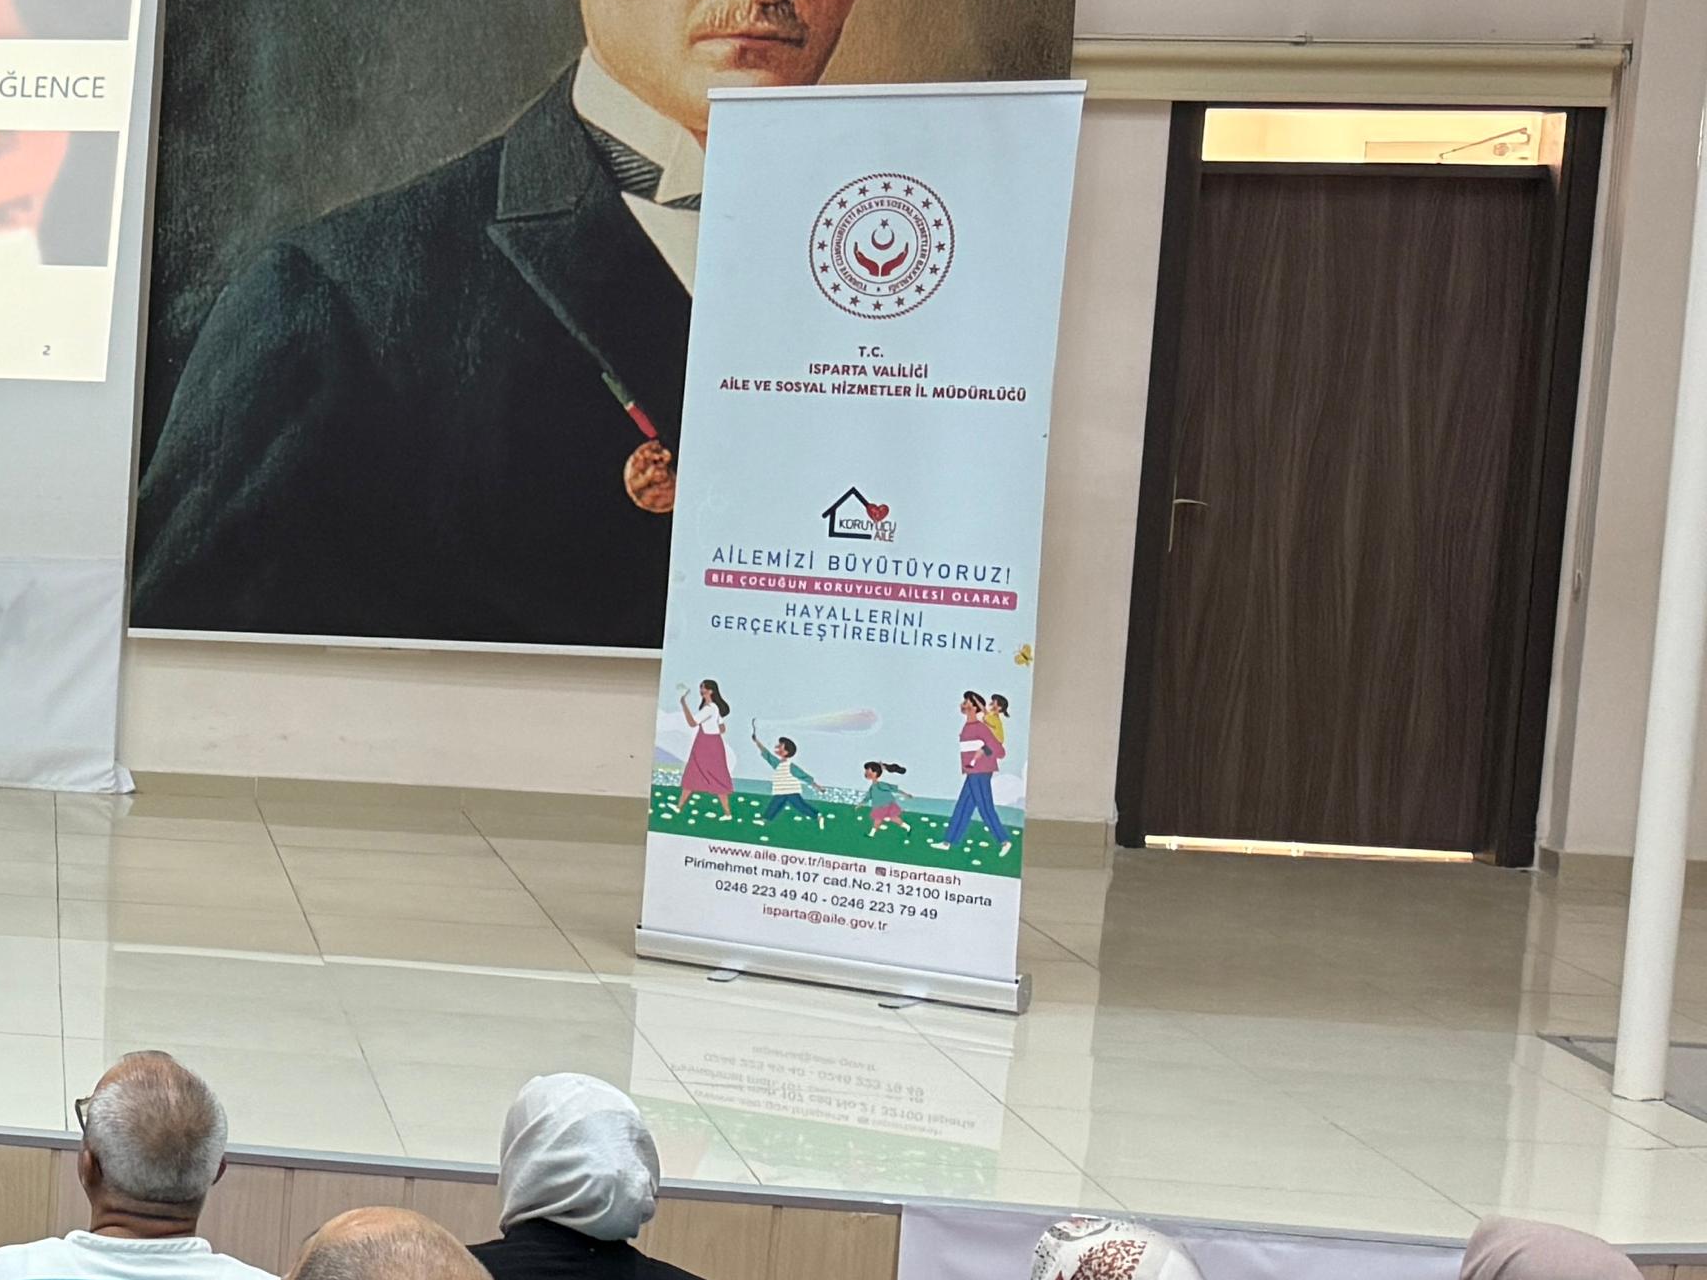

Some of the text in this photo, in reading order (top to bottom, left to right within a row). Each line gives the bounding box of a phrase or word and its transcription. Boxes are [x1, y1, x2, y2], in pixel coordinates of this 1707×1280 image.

[42, 344, 51, 356] 2
[858, 346, 884, 358] T.C.
[809, 362, 928, 379] ISPARTA VALİLİĞİ
[720, 376, 1026, 402] AİLE VE SOSYAL HİZMETLER İL MÜDÜRLÜĞÜ
[712, 544, 1011, 584] AİLEMİZİ BÜYÜTÜYORUZ!
[711, 571, 1010, 606] BİR ÇOCUĞUN KORUYUCU AİLESİ OLARAK
[786, 603, 923, 628] HAYALLERİNİ
[684, 856, 758, 877] Pirimehmet
[896, 883, 940, 901] 32100
[944, 890, 992, 908] Isparta
[889, 866, 962, 887] ispartaash
[715, 879, 748, 894] 0246
[751, 884, 777, 898] 223
[779, 887, 798, 901] 49
[801, 890, 819, 904] 40
[830, 895, 865, 911] 0246
[869, 900, 895, 915] 223
[899, 903, 916, 918] 79
[919, 906, 938, 921] 49
[762, 903, 888, 932] isparta@aile.gov.tr
